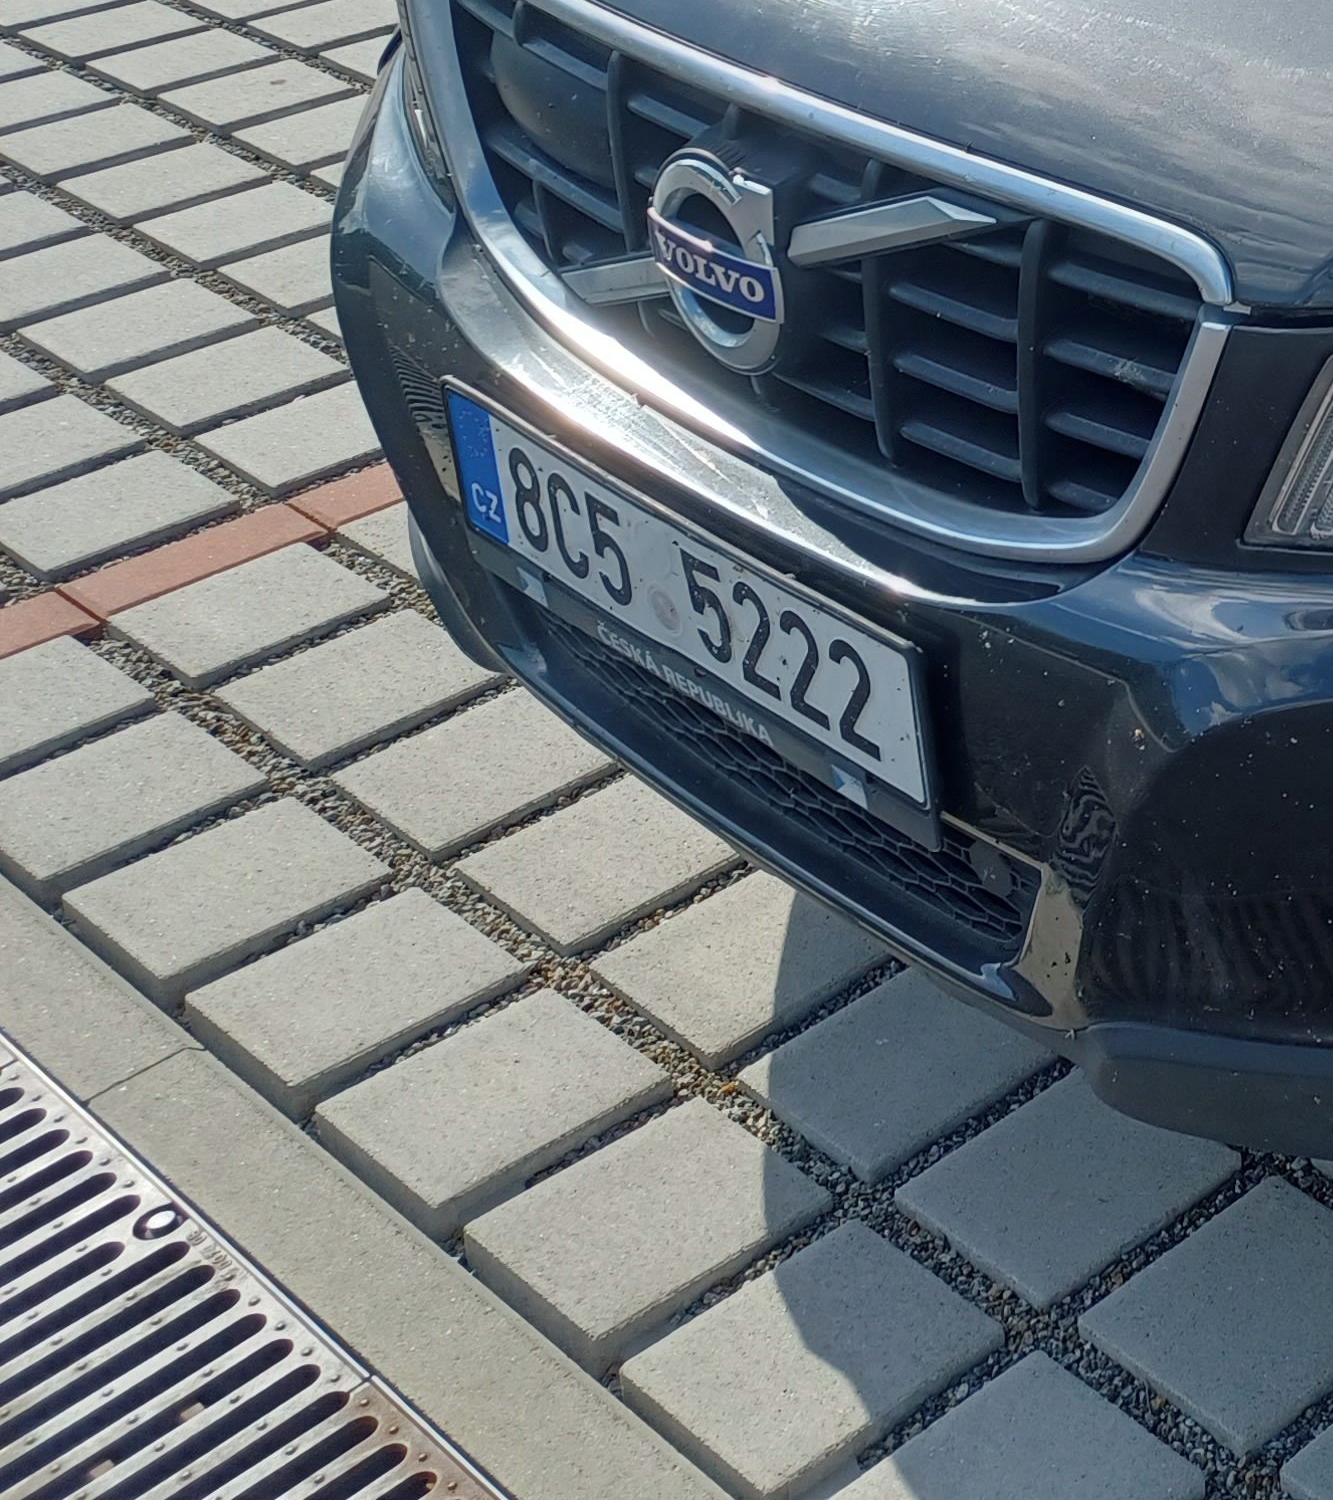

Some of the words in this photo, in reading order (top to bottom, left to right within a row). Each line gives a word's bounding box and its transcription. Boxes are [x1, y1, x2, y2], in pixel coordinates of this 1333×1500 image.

[654, 229, 765, 303] VOLVO
[470, 481, 502, 524] CZ
[508, 446, 632, 607] 8C5
[680, 548, 883, 761] 5222
[597, 619, 662, 678] ČESKÁ
[661, 664, 775, 748] REPUBLIKA
